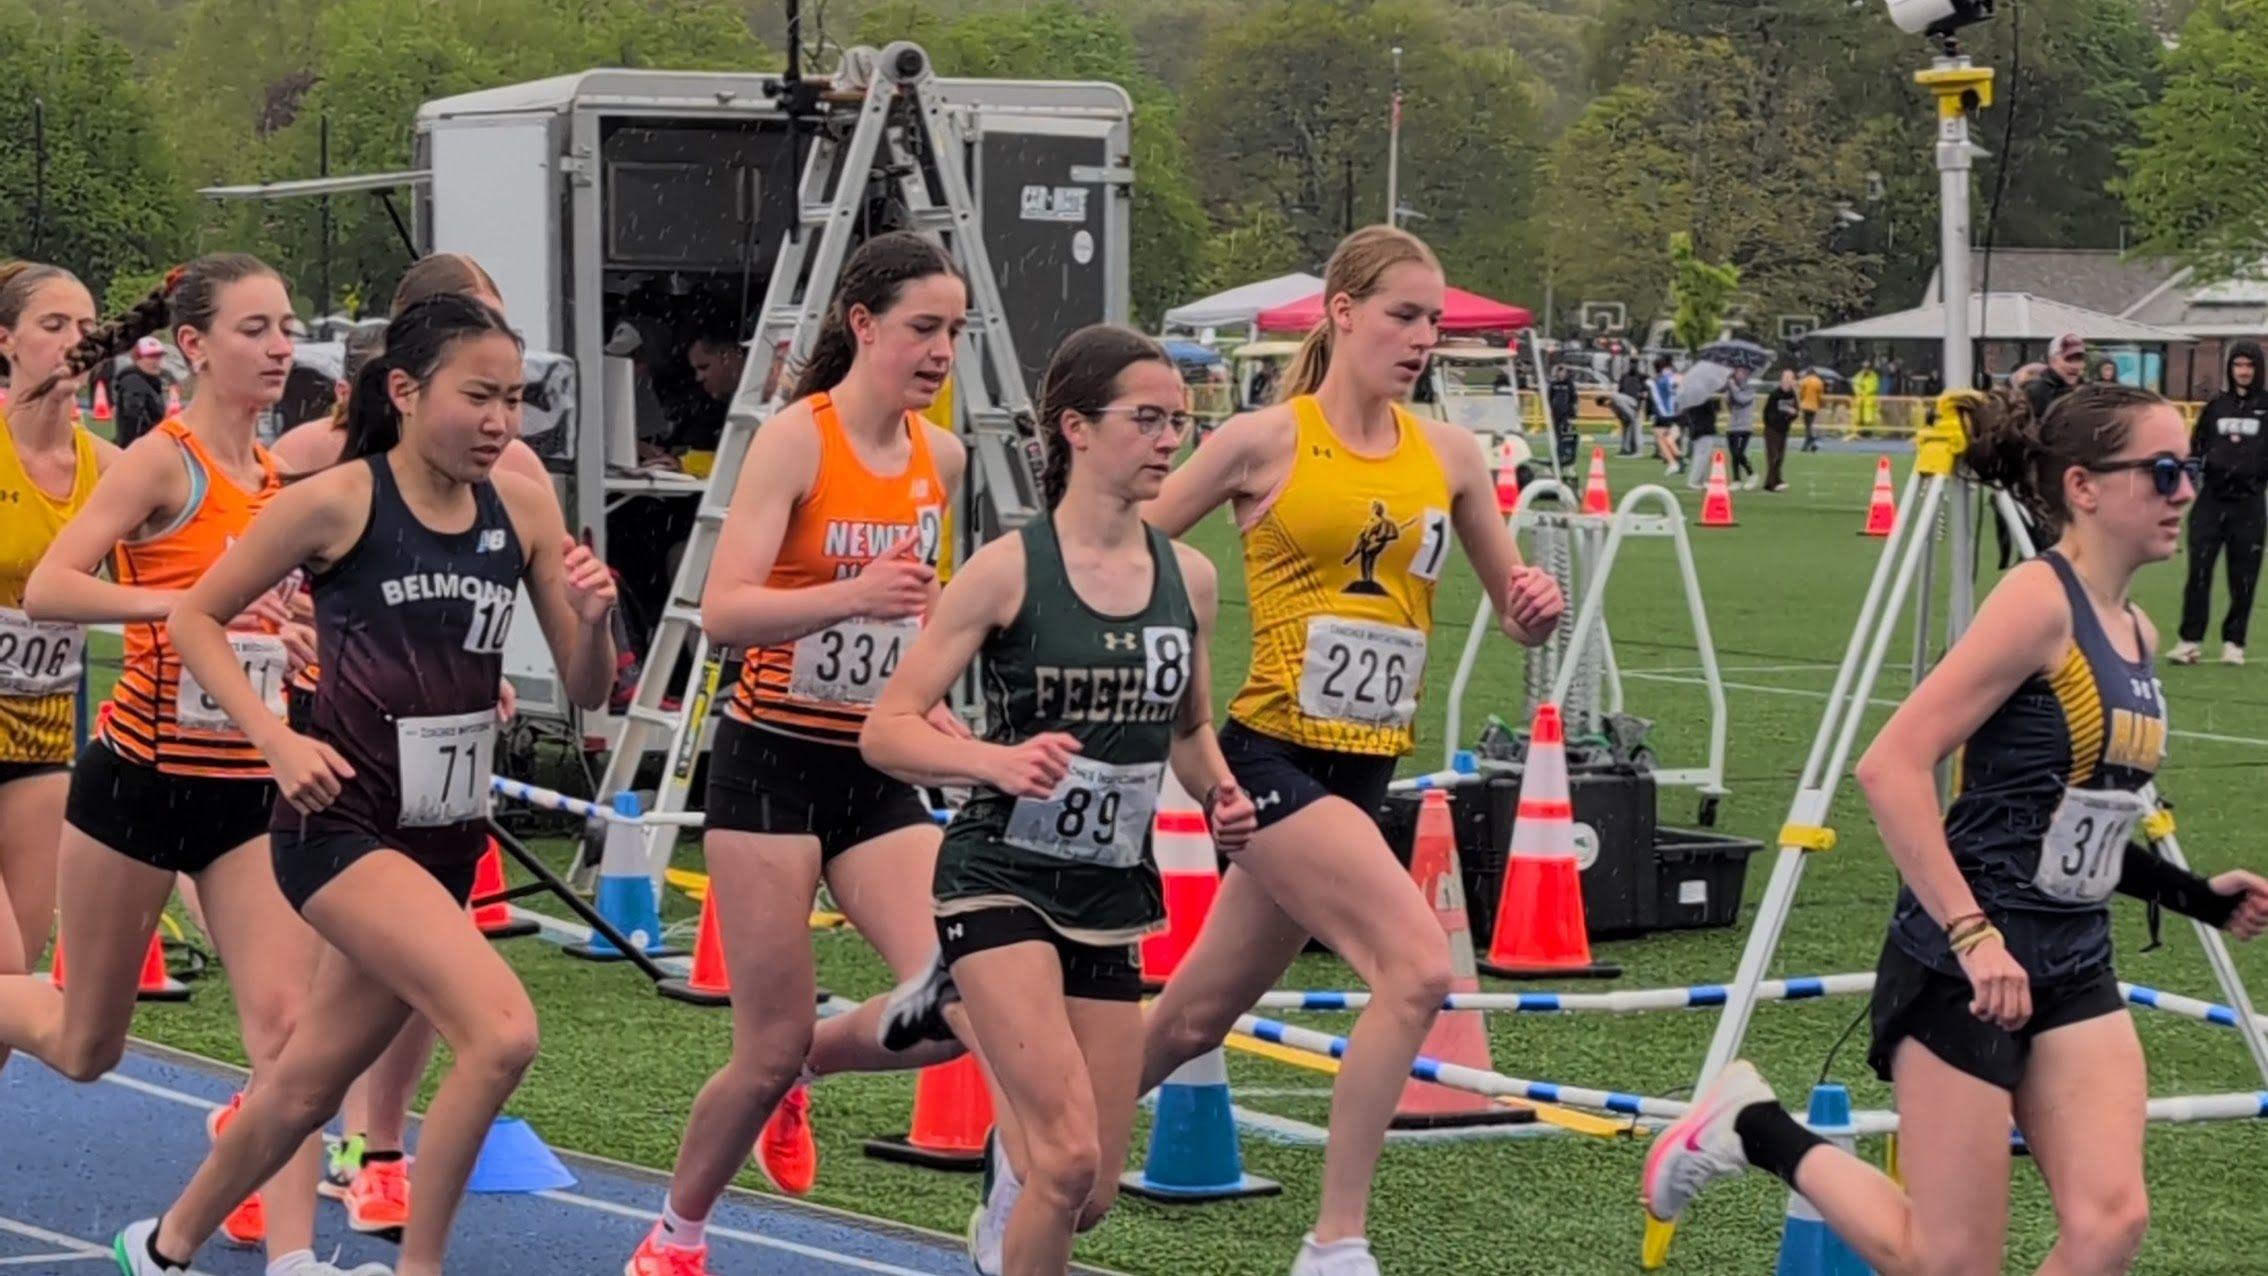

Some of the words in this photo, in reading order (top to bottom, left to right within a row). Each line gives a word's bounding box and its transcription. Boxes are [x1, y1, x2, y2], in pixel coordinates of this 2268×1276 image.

[825, 520, 921, 558] NEWT
[1425, 517, 1445, 574] 1
[476, 601, 514, 649] 10
[0, 632, 71, 678] 206
[1154, 633, 1183, 697] 8
[1322, 643, 1405, 707] 226
[1035, 666, 1177, 723] FEEH
[439, 741, 477, 803] 71
[1056, 787, 1121, 845] 89
